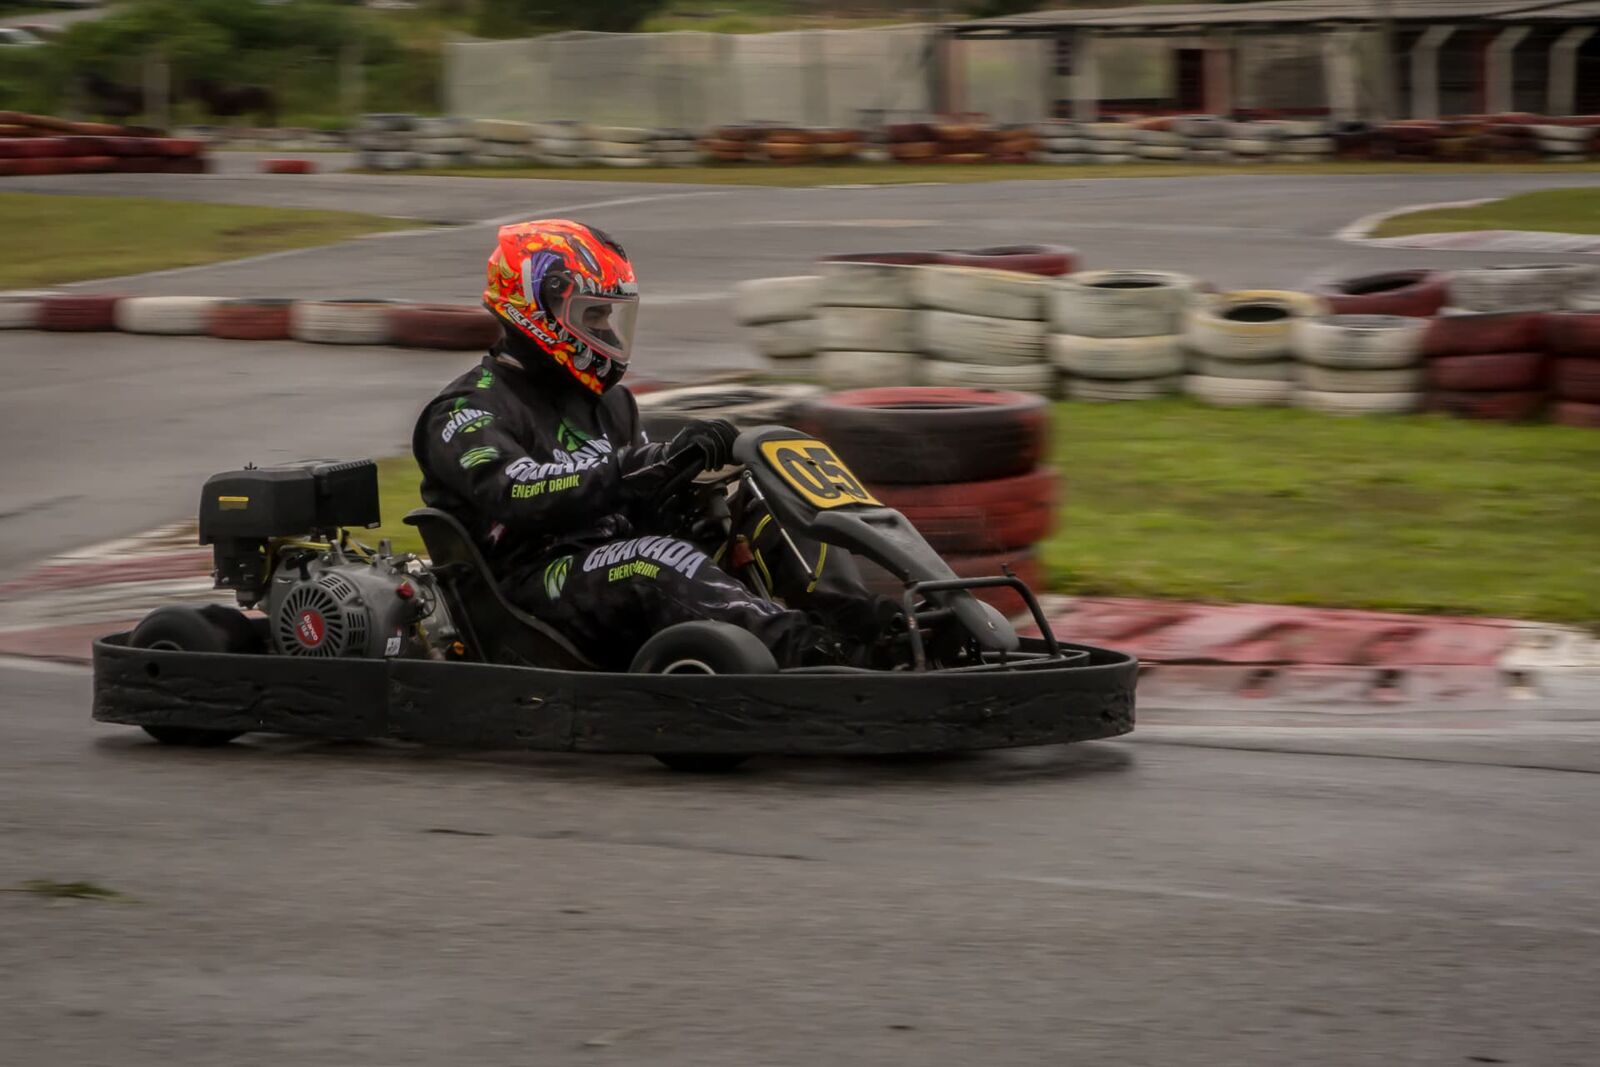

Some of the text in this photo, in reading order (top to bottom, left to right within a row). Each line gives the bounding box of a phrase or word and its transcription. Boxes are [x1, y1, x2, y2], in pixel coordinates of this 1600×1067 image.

[511, 475, 580, 498] ENERGY DRINK
[776, 447, 868, 500] 05
[583, 535, 707, 579] GRANADA
